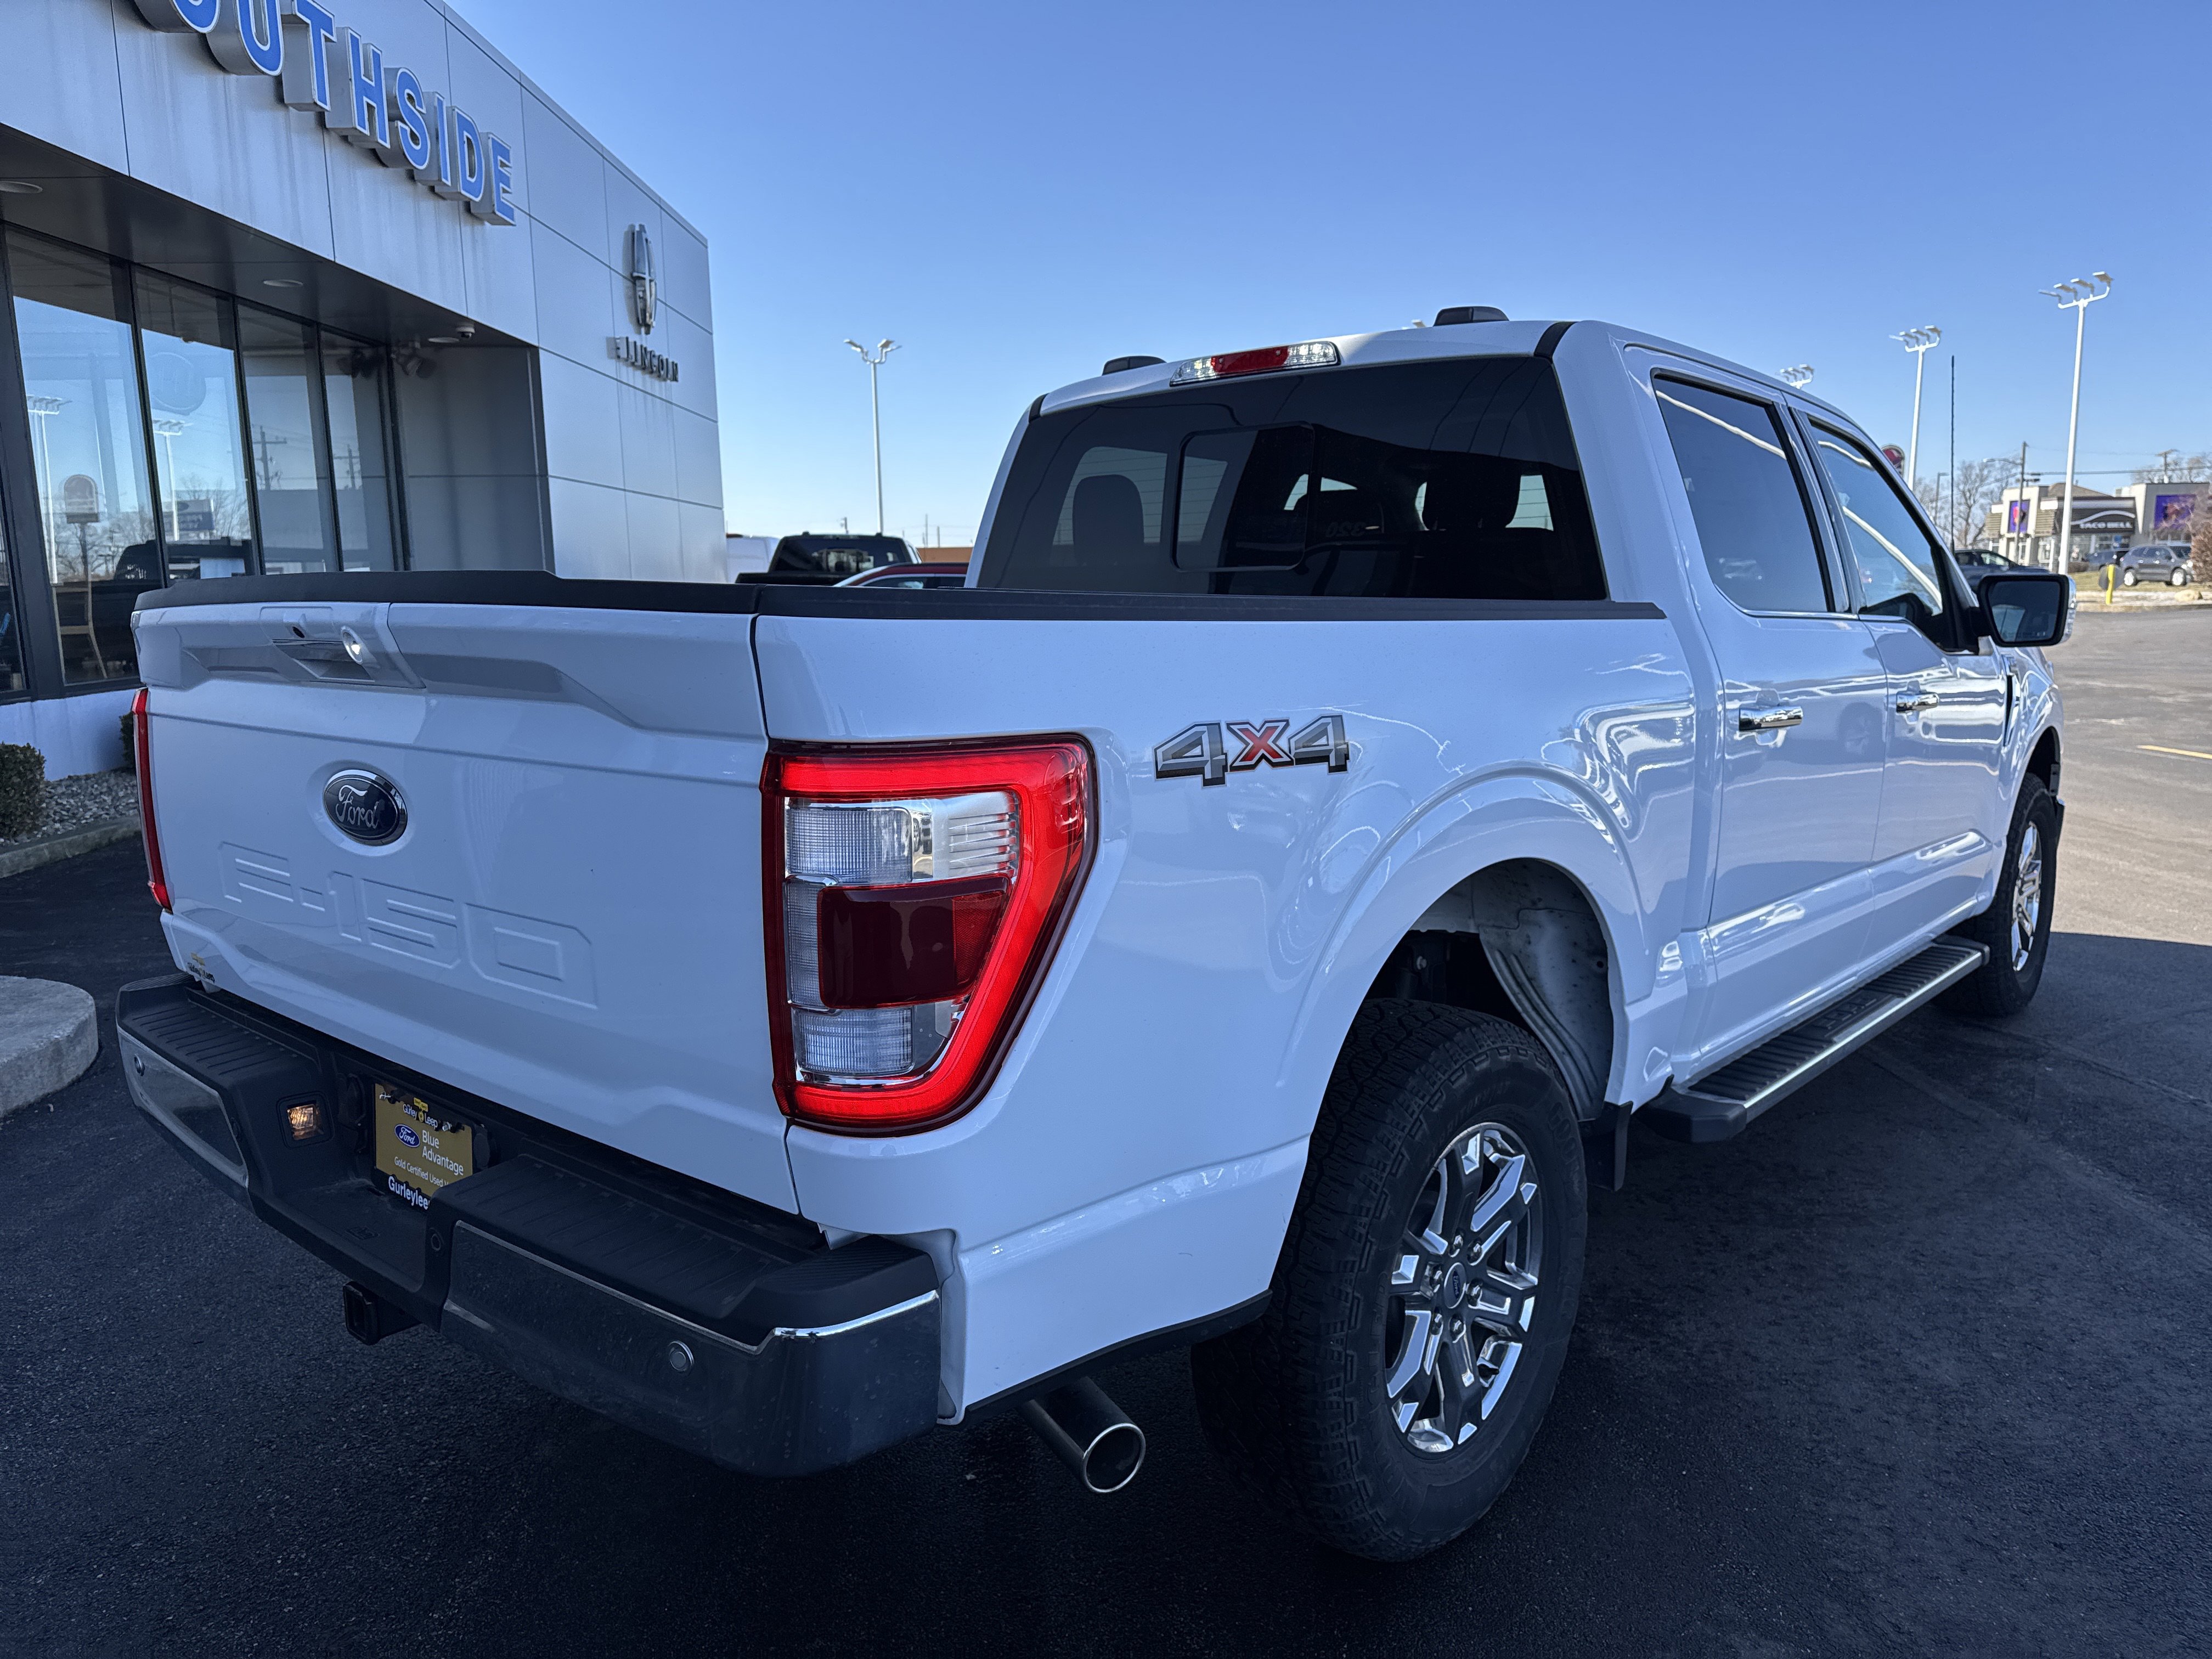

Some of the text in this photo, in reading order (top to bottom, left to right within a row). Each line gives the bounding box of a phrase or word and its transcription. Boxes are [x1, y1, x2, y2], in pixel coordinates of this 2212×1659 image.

[156, 0, 516, 226] UTHSIDE
[335, 785, 380, 829] Ford
[220, 841, 599, 1011] F-150
[399, 1126, 415, 1144] Ford
[422, 1130, 439, 1149] Blue
[394, 1156, 406, 1169] Gold
[407, 1163, 428, 1180] Certified
[429, 1173, 443, 1187] Used
[422, 1146, 464, 1176] Advantage
[388, 1176, 430, 1210] Gurleylee
